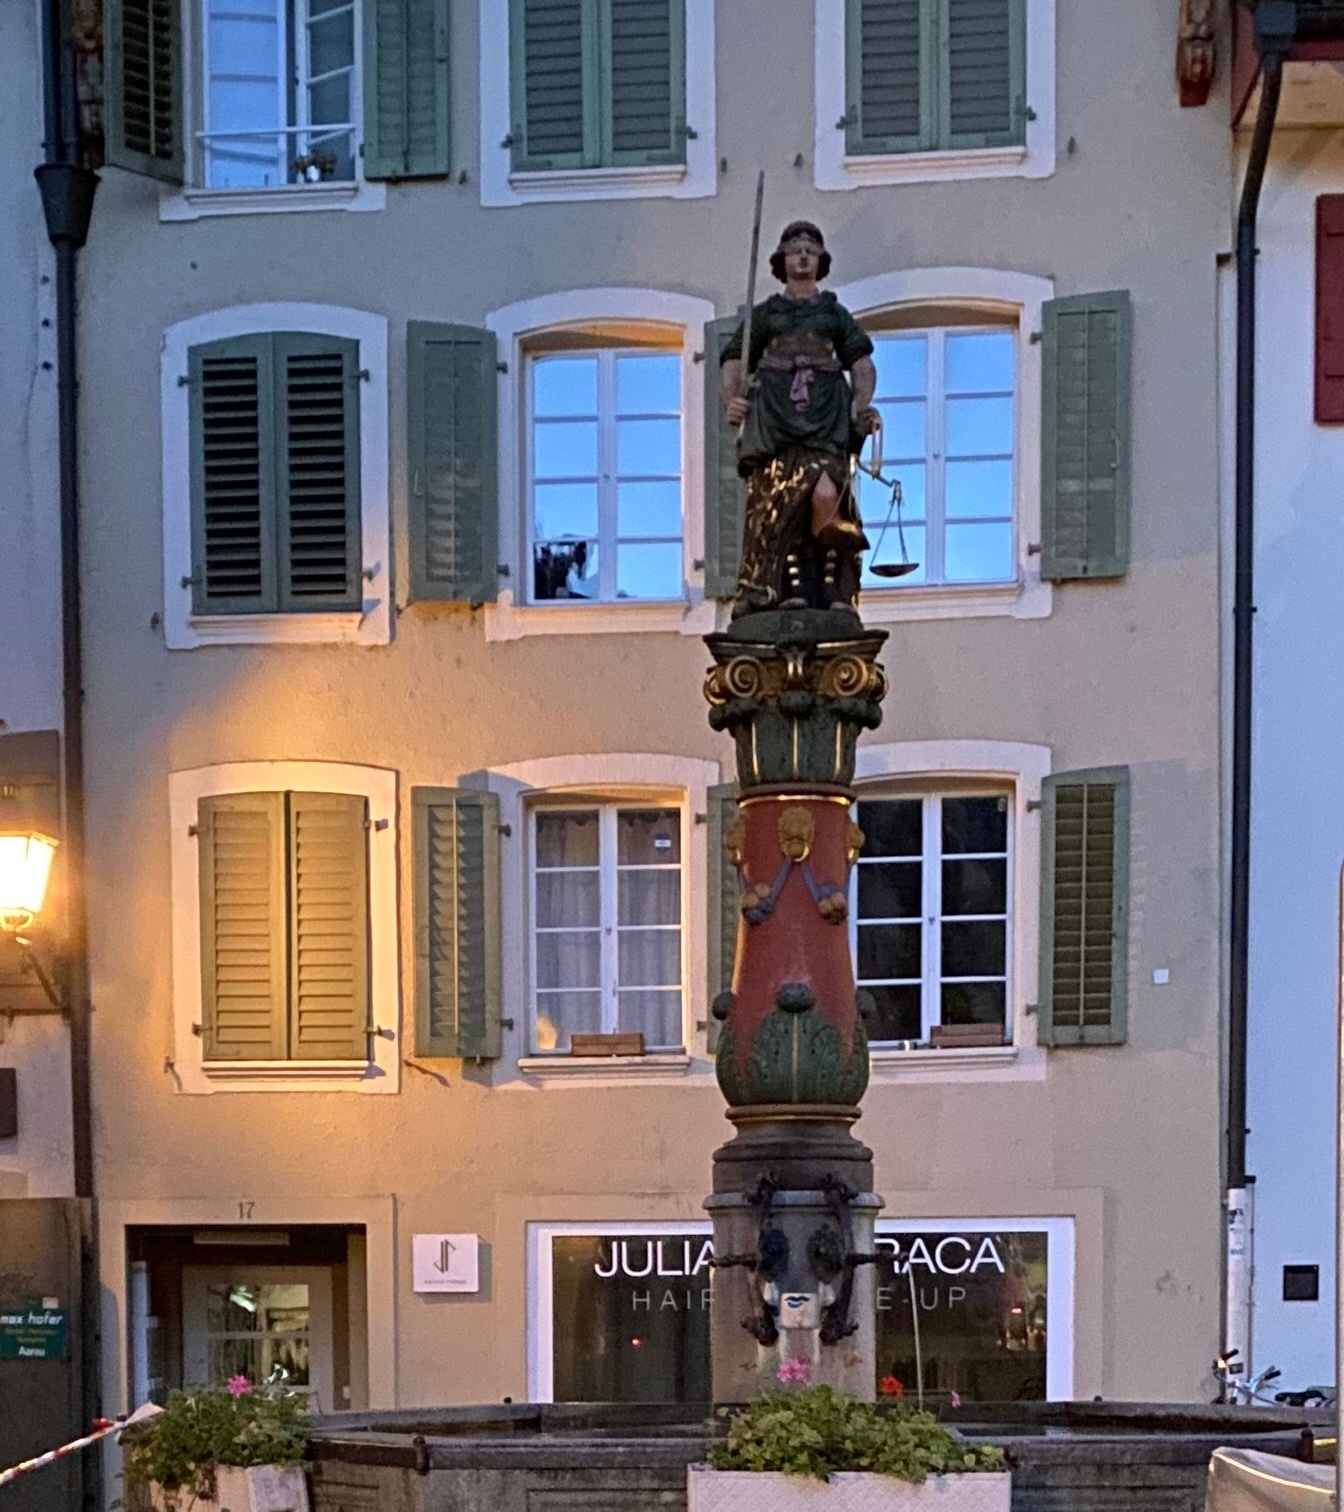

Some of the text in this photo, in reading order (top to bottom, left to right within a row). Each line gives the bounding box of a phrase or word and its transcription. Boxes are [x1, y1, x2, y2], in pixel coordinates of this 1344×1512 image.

[239, 1201, 256, 1220] 17
[594, 1236, 1006, 1278] JULIA RACA
[875, 1286, 967, 1311] E-UP
